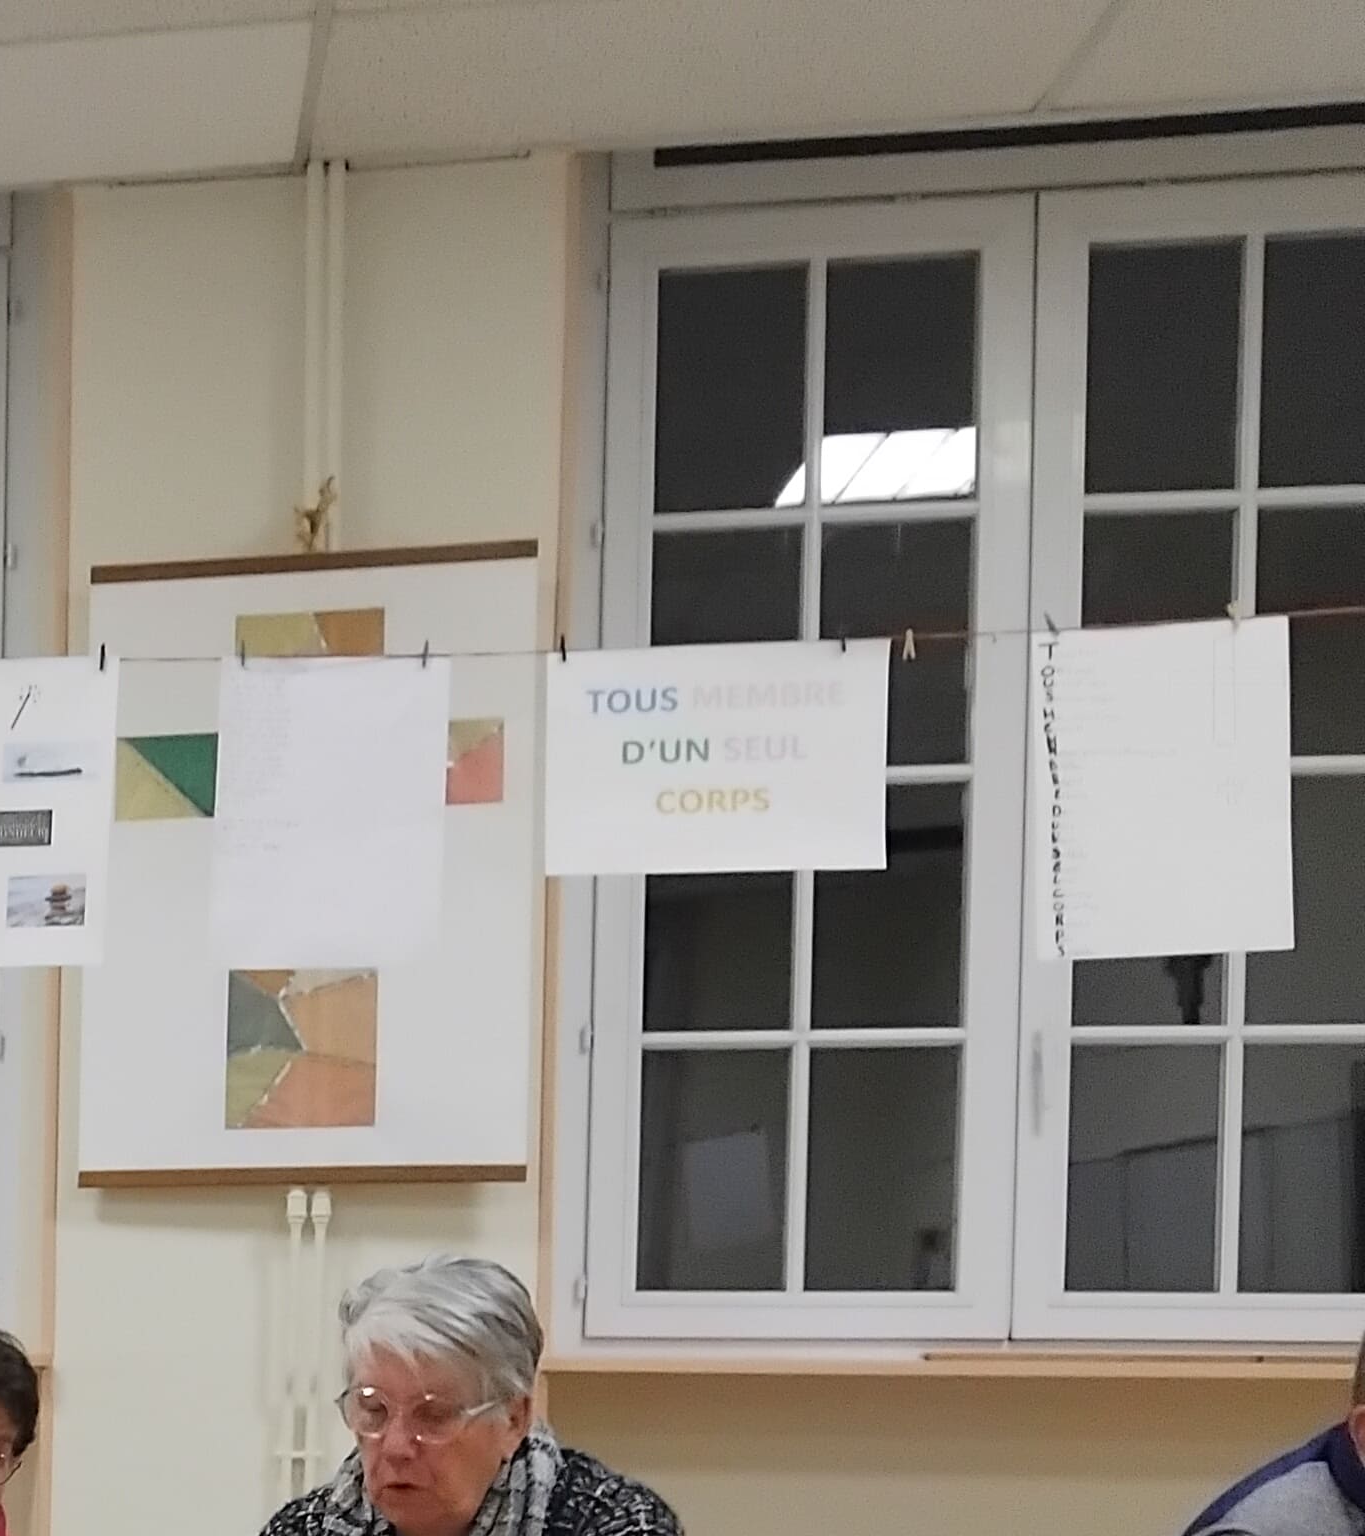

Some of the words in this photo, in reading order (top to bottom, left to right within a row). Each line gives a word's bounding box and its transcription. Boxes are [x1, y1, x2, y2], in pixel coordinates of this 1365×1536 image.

[586, 687, 679, 714] TOUS
[692, 682, 846, 709] MEMBRE
[622, 738, 710, 765] D'UN
[724, 735, 807, 762] SEUL
[656, 788, 771, 814] CORPS
